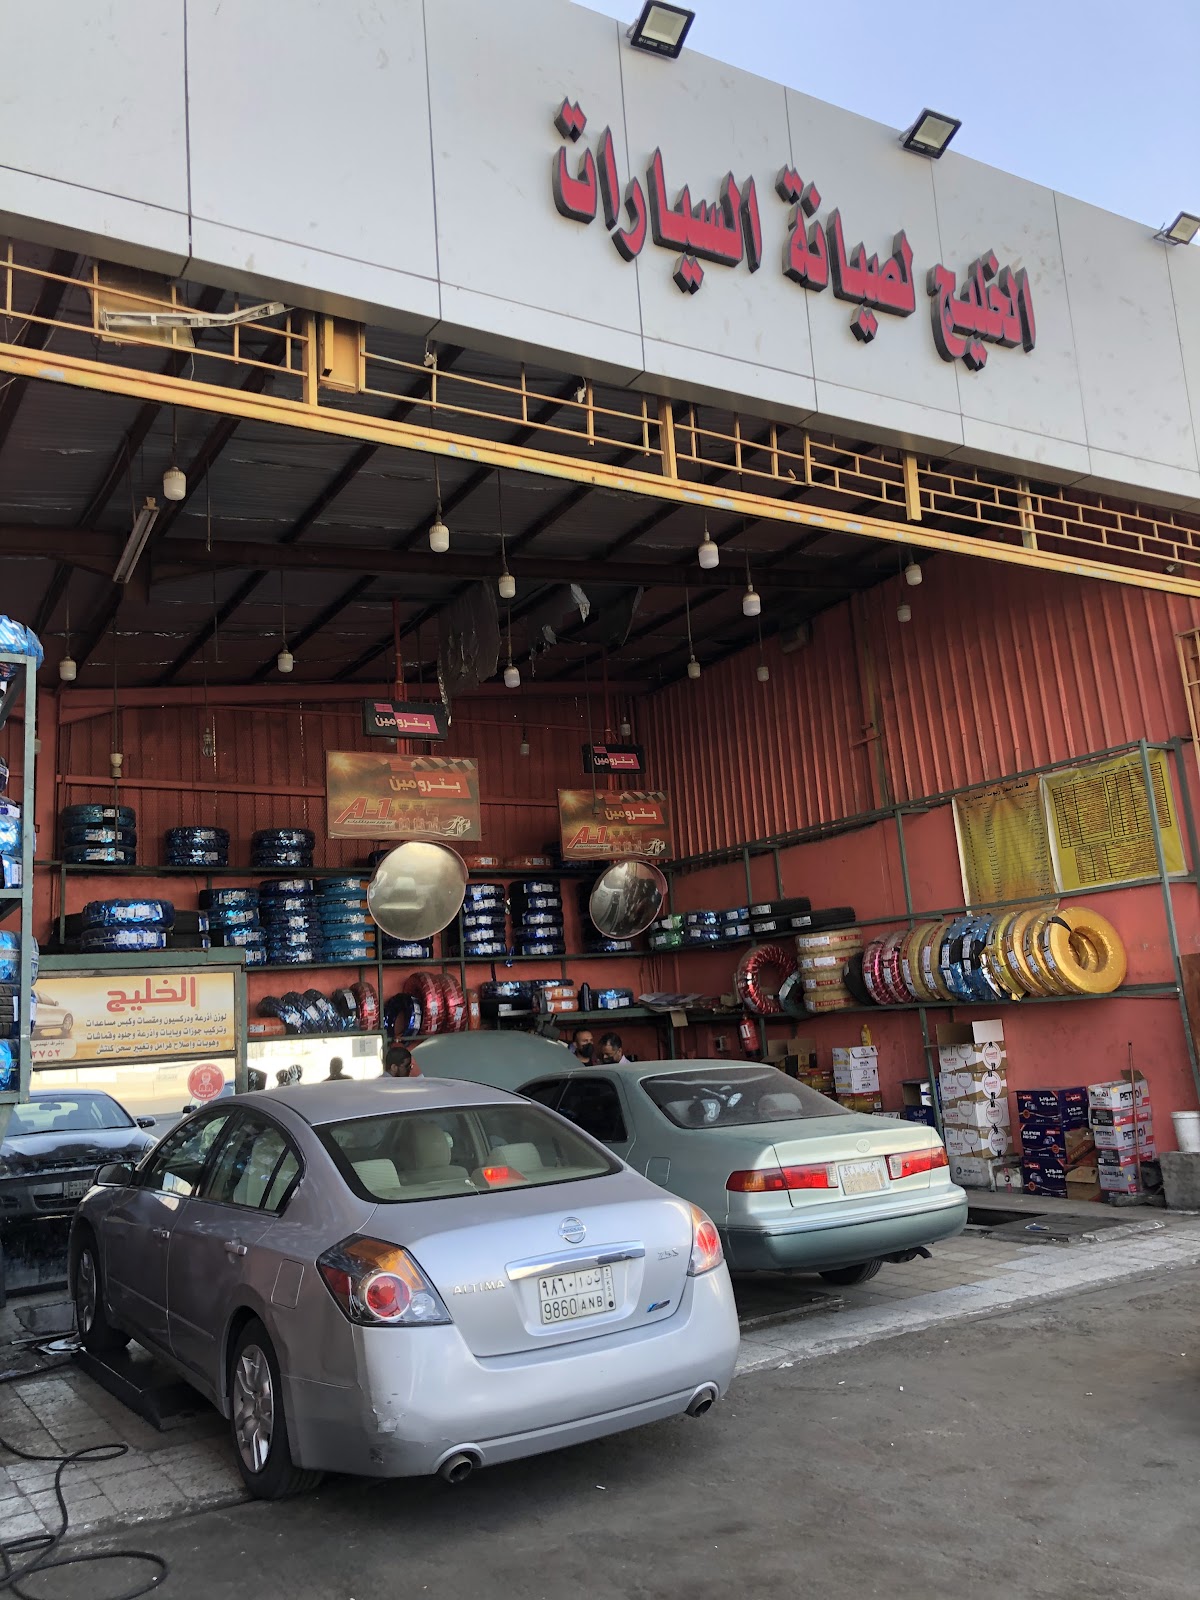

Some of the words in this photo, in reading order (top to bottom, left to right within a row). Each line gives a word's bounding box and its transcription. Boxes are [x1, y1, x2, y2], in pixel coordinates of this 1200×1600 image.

[552, 96, 763, 295] السيارات
[775, 163, 916, 344] لصيانة
[926, 248, 1037, 371] الخليج
[374, 714, 431, 730] بترومين
[593, 755, 634, 766] بترومين
[389, 775, 461, 793] بترومين
[334, 796, 393, 824] A-1
[604, 807, 657, 820] بترومين
[567, 825, 607, 849] A-1
[106, 976, 197, 1013] الخليج
[453, 1280, 506, 1295] ALTIMA
[544, 1298, 577, 1321] 9860
[582, 1296, 603, 1311] ANB
